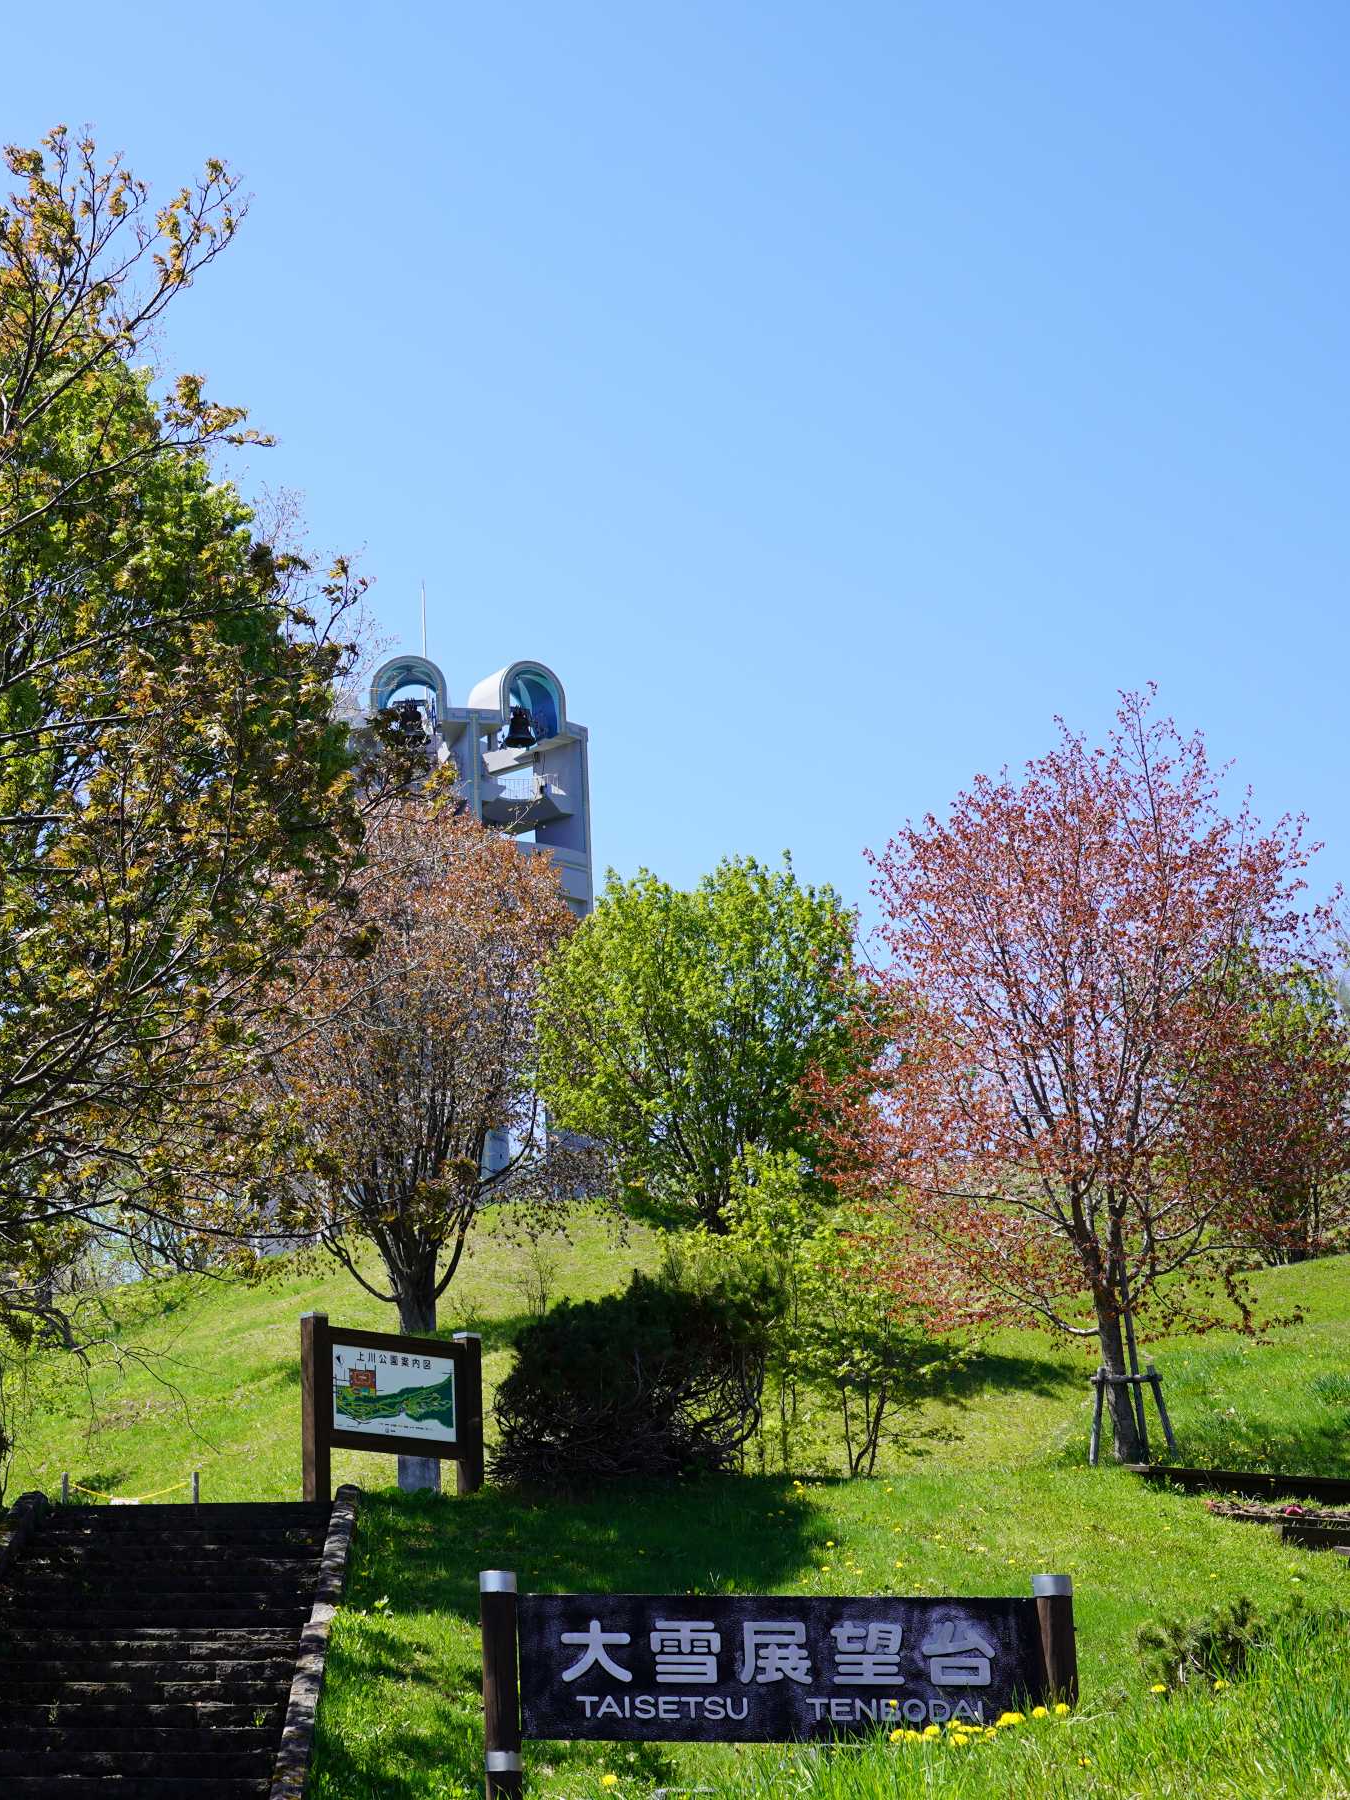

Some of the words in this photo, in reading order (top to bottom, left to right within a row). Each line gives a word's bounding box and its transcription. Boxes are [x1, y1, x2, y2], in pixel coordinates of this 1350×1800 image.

[356, 1351, 431, 1369] 上川公園案内図
[560, 1620, 995, 1686] 大雪展望台
[576, 1695, 750, 1720] TAISETSU
[806, 1697, 984, 1722] TENBODAI
